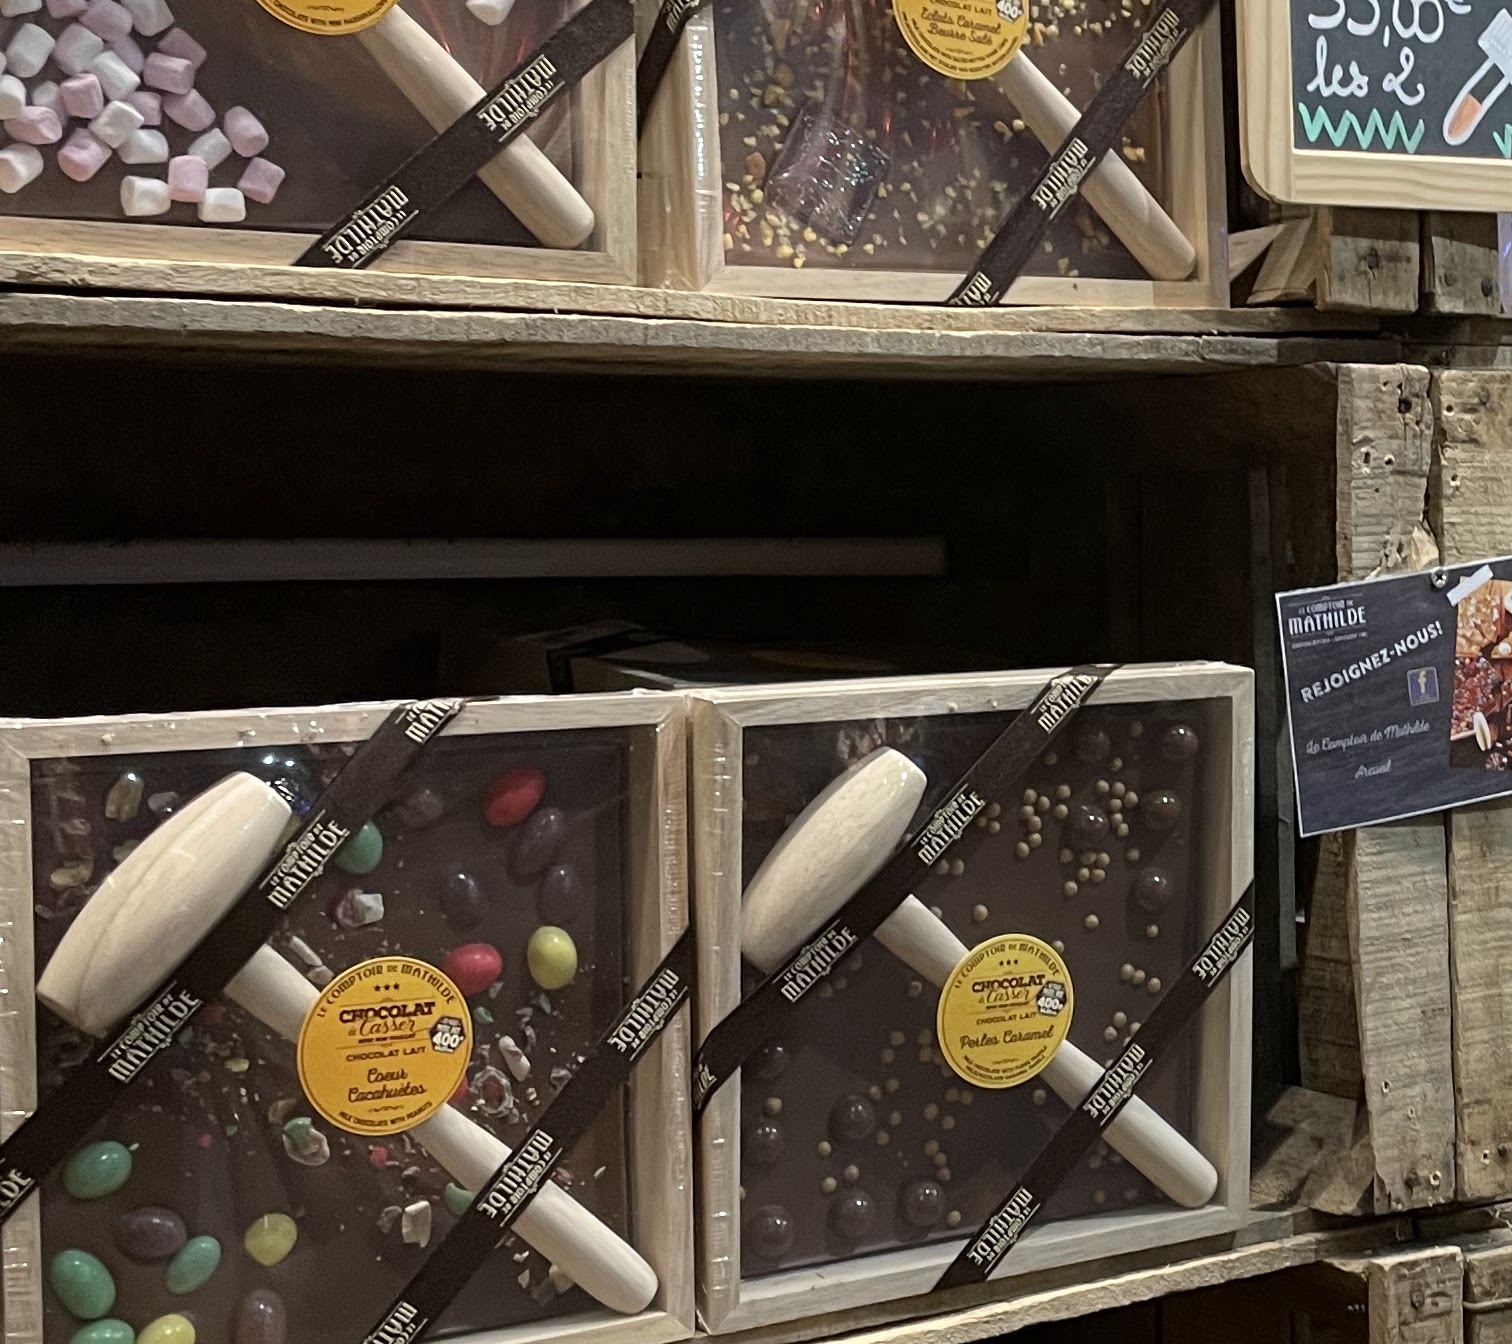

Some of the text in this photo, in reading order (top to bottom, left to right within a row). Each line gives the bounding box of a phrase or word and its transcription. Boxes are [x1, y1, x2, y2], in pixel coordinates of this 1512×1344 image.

[956, 15, 1001, 35] Caramel
[974, 6, 992, 16] LAIT
[477, 54, 557, 131] MATHILDE
[1306, 34, 1425, 107] les 2
[324, 185, 409, 264] MATHILDE
[1288, 606, 1367, 635] MATHILDE
[1300, 621, 1443, 703] REJOIGNEZ-NOUS!
[1384, 719, 1431, 739] Mathilde
[918, 791, 986, 866] MATHILDE
[268, 820, 349, 909] MATHILDE
[781, 927, 859, 1002] MATHILDE
[1191, 907, 1252, 981] MATHILDE
[328, 964, 457, 1005] COMPTOIR MATHILDE
[608, 969, 679, 1052] MATHILDE
[972, 974, 1045, 993] CHOCOLAT
[987, 987, 1030, 1004] Casser
[108, 990, 200, 1083] MATHILDE
[339, 1002, 436, 1024] CHOCOLAT
[359, 1017, 416, 1037] Casser
[960, 1024, 1054, 1050] Perles Caramel
[976, 1012, 1037, 1026] CHOCOLAT LAIT
[346, 1046, 427, 1062] CHOCOLAT LAIT
[367, 1067, 408, 1083] Coeur
[1084, 1044, 1146, 1118] MATHILDE
[477, 1129, 553, 1219] MATHILDE
[966, 1187, 1034, 1266] MATHILDE
